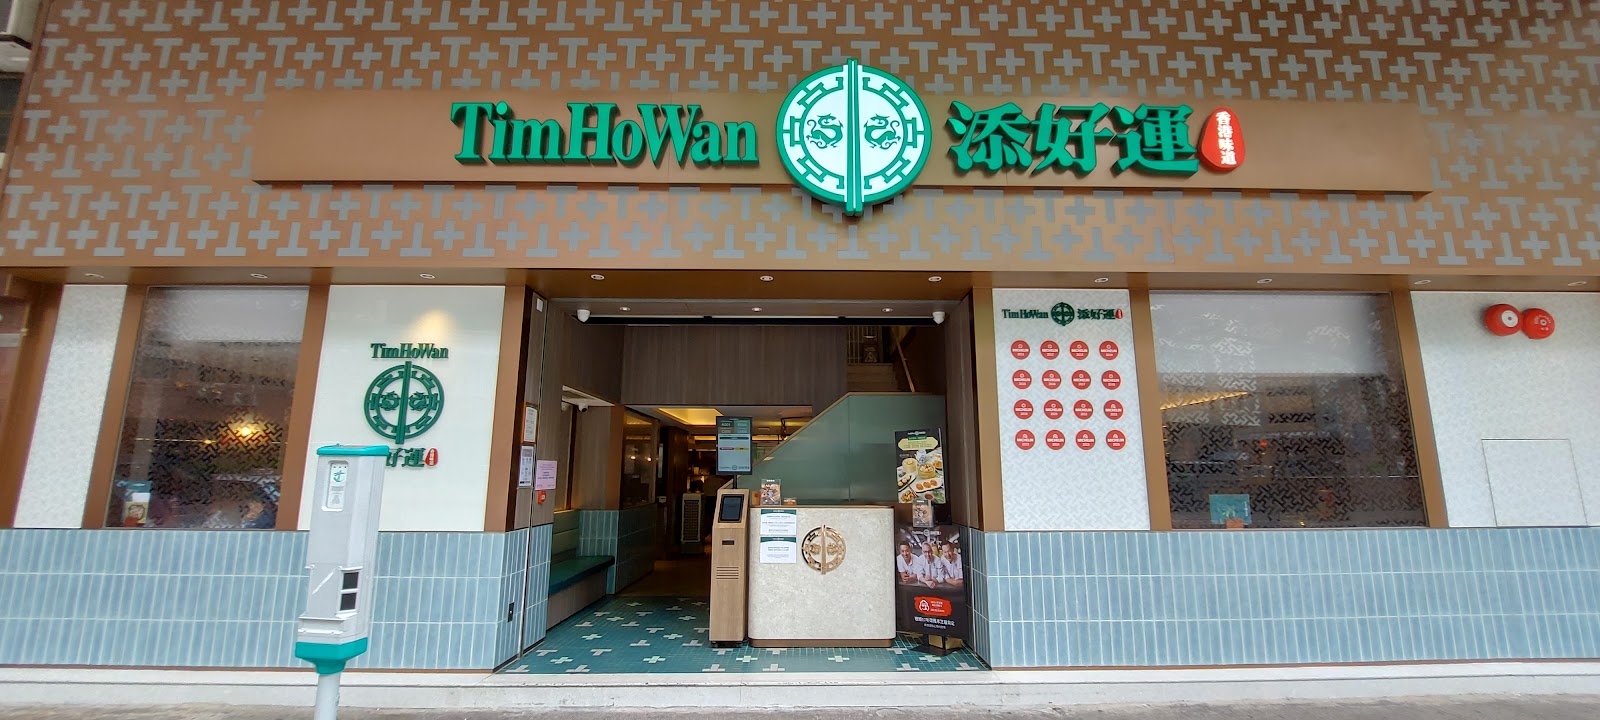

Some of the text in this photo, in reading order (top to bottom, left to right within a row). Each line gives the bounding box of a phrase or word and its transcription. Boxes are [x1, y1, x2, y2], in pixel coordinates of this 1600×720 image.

[946, 100, 1200, 176] 添好運
[1215, 110, 1237, 165] 香港味道
[385, 448, 426, 468] 好運
